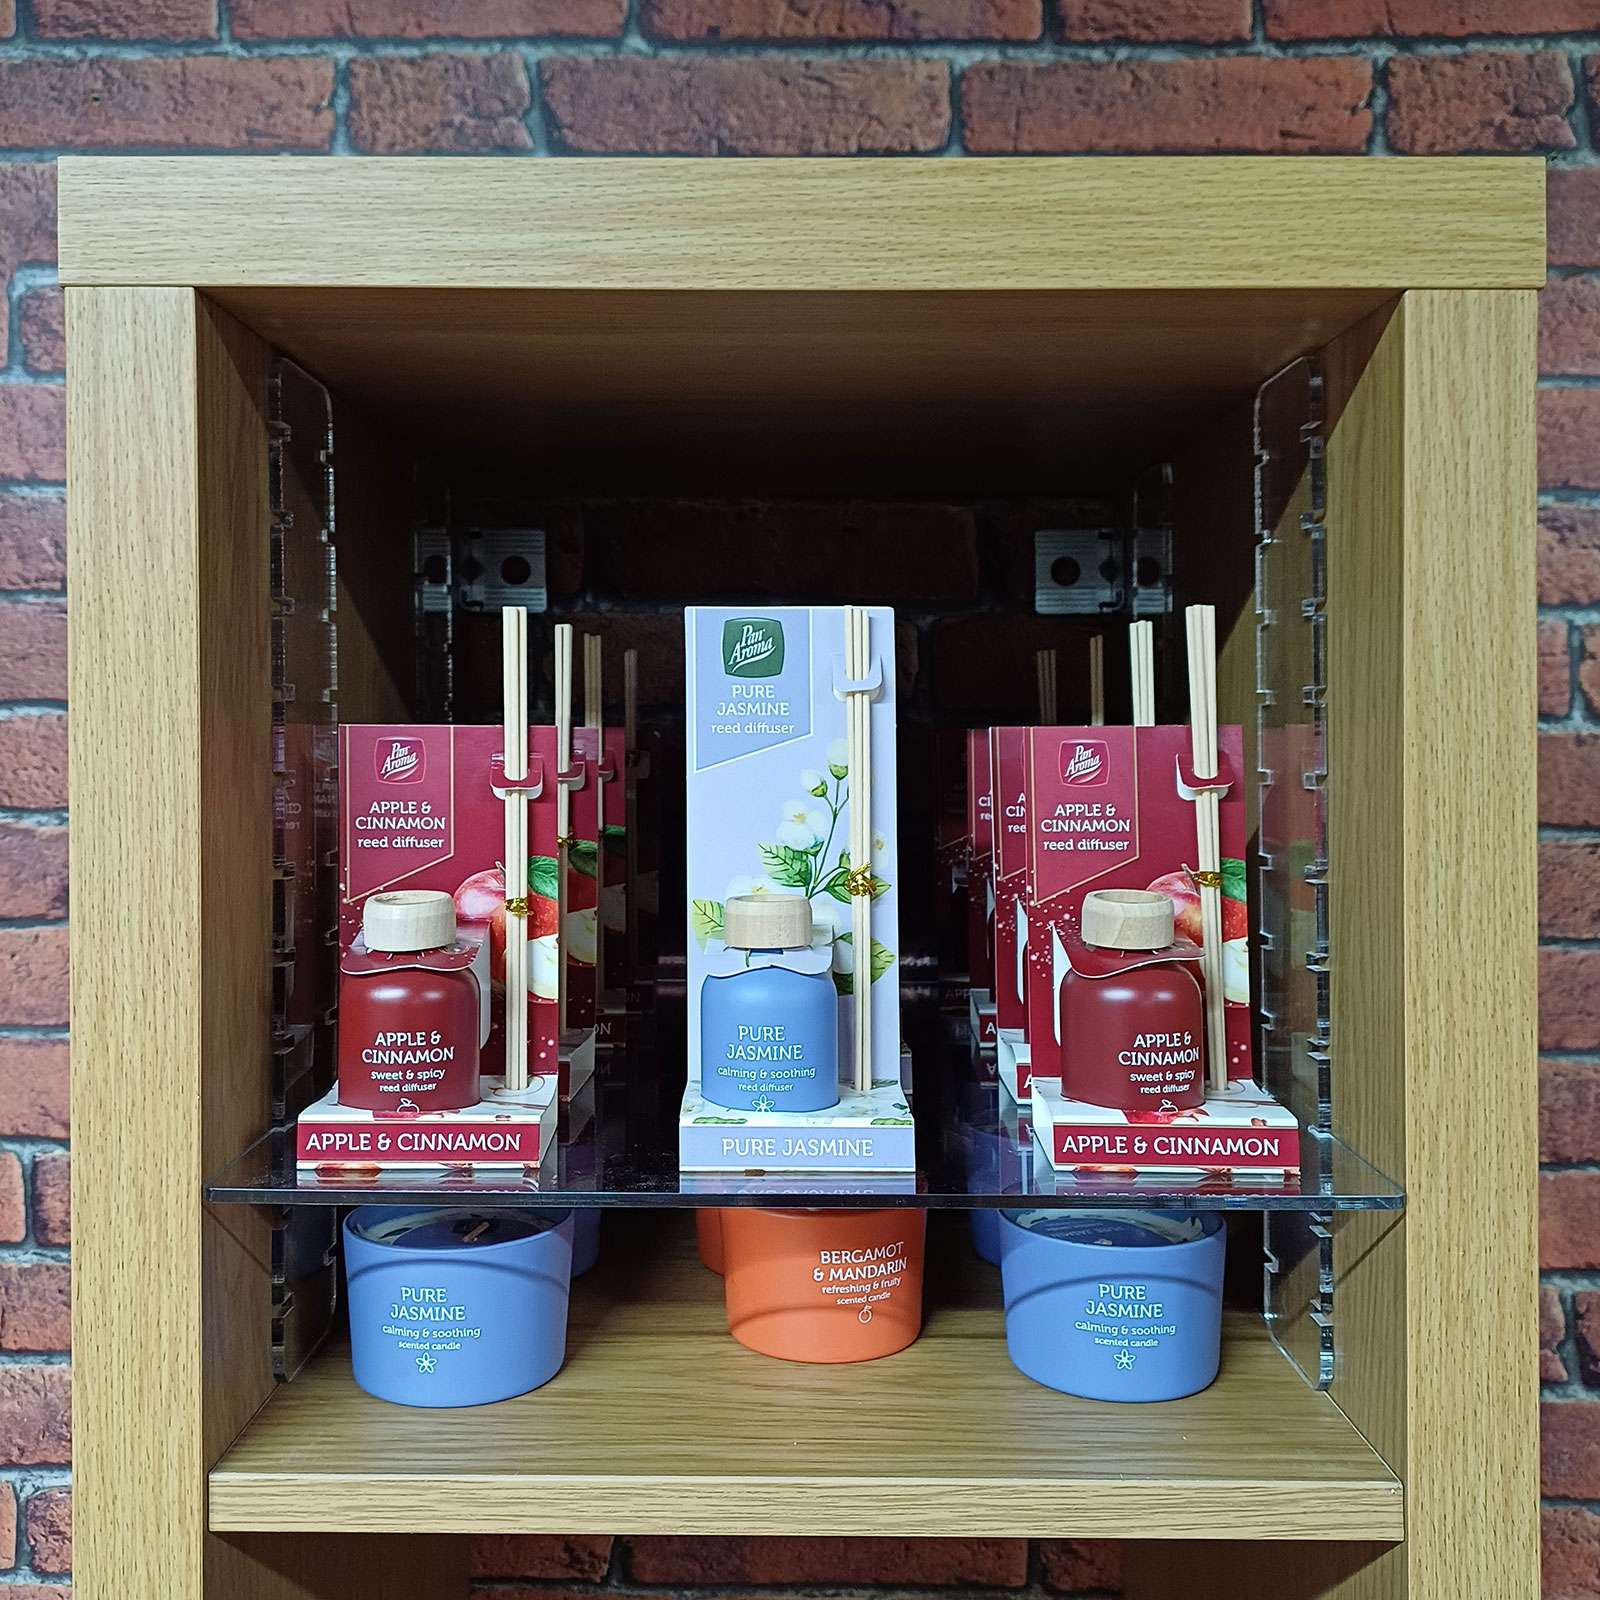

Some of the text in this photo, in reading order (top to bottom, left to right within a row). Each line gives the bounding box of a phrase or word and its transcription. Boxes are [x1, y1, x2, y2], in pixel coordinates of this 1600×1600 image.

[741, 625, 765, 648] Pan
[728, 637, 773, 666] Aroma
[732, 684, 775, 699] PURE
[717, 702, 790, 717] JASMINE
[711, 722, 795, 734] reed diffuser
[391, 742, 411, 760] Pan
[1074, 745, 1093, 762] Pan
[380, 753, 417, 775] Aroma
[1063, 754, 1100, 777] Aroma
[369, 801, 432, 815] APPLE &
[1054, 804, 1117, 817] APPLE &
[355, 816, 446, 830] CINNAMON
[1008, 824, 1026, 833] ree
[1040, 819, 1131, 832] CINNAMON
[357, 836, 444, 848] reed diffuser
[1043, 839, 1130, 851] reed diffuser
[375, 1030, 441, 1047] APPLE &
[738, 1025, 785, 1041] PURE
[1133, 1032, 1192, 1048] APPLE &
[361, 1046, 455, 1064] CINNAMON
[726, 1044, 803, 1061] JASMINE
[1118, 1046, 1200, 1067] CINNAMON
[370, 1068, 446, 1082] sweet & spicy
[717, 1066, 816, 1081] calming & soothing
[1129, 1069, 1195, 1083] sweet & spicy
[379, 1082, 437, 1093] reed diffuser
[738, 1082, 793, 1092] reed diffuser
[1139, 1082, 1190, 1093] reed diffuser
[306, 1133, 521, 1151] APPLE & CINNAMON
[721, 1138, 873, 1157] PURE JASMINE
[1062, 1135, 1279, 1157] APPLE & CINNAMON
[820, 1241, 904, 1265] BERGAMOT
[812, 1256, 908, 1282] & MANDARIN
[822, 1277, 902, 1294] refreshing & fruity
[1098, 1283, 1146, 1300] PURE
[400, 1287, 447, 1303] PURE
[836, 1291, 891, 1305] scented candle
[390, 1304, 466, 1321] JASMINE
[1085, 1300, 1163, 1318] JASMINE
[382, 1324, 481, 1339] calming & soothing
[1074, 1320, 1176, 1336] calming & soothing
[398, 1340, 461, 1350] scented candle
[1094, 1336, 1159, 1347] scented candle
